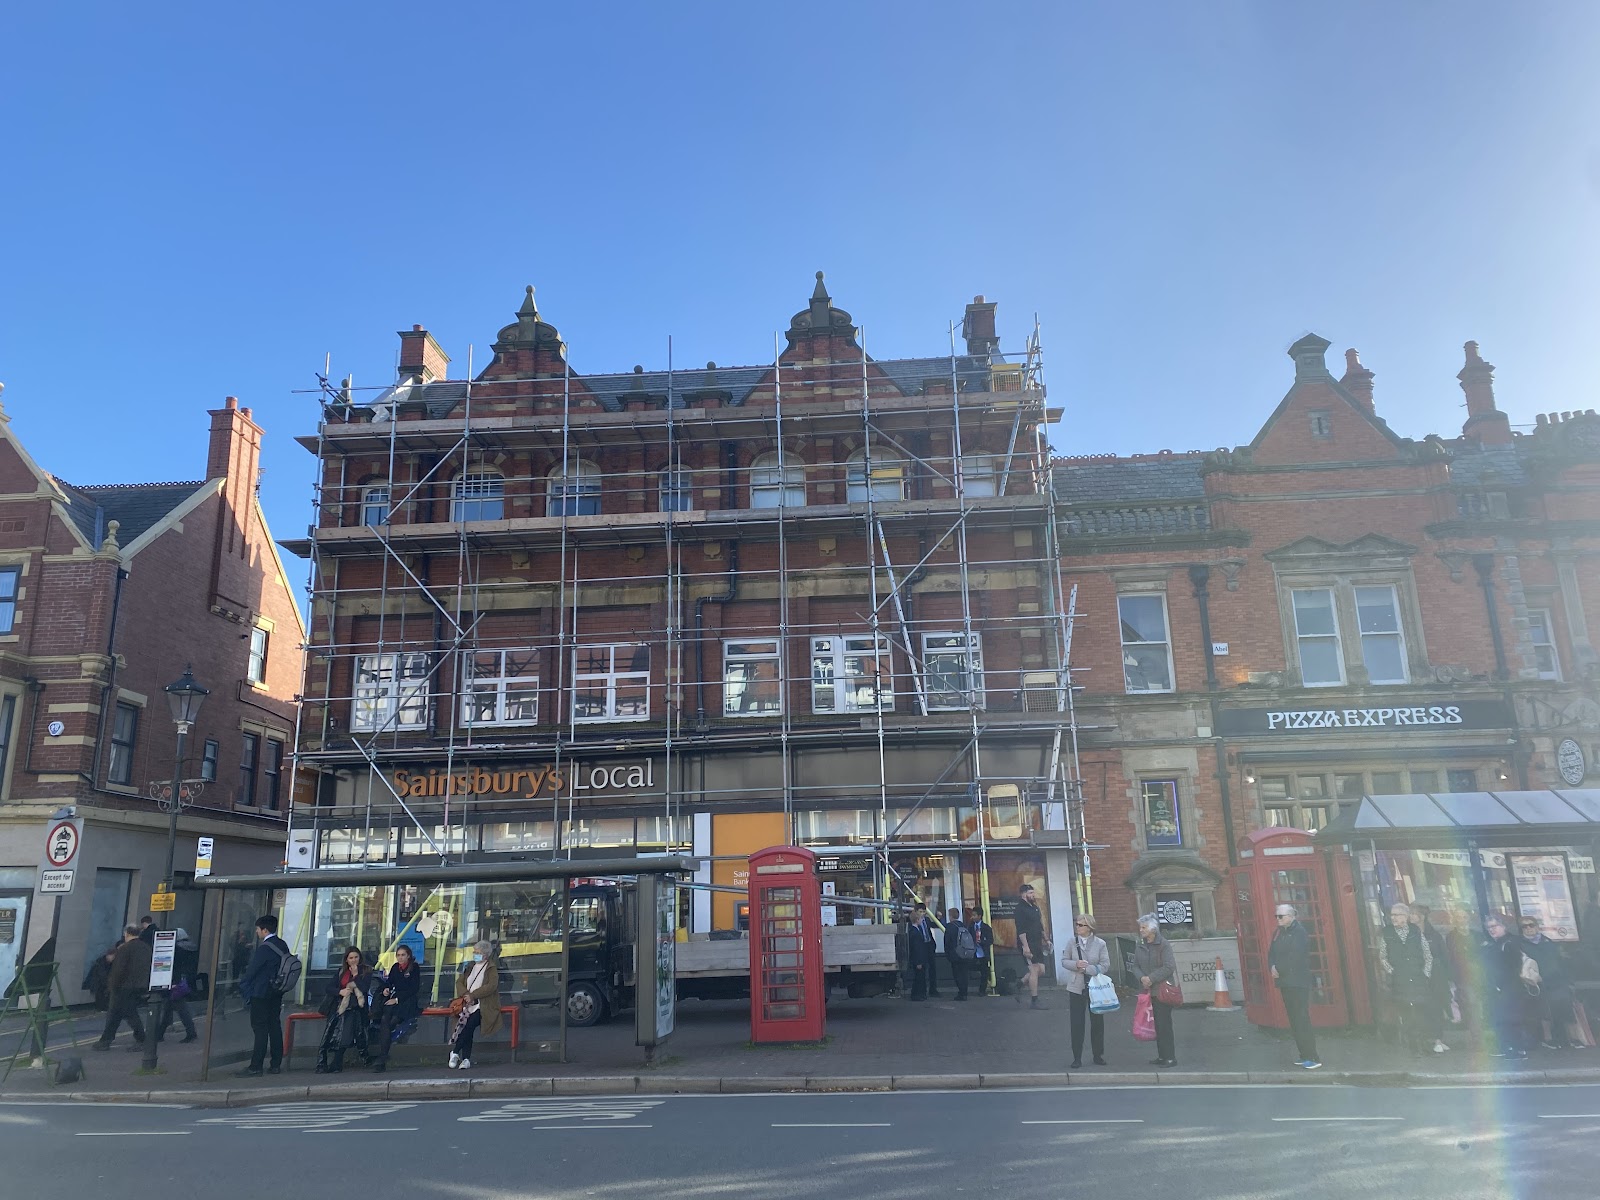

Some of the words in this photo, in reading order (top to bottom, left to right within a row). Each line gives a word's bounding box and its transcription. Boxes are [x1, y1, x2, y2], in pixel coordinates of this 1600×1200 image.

[1266, 710, 1342, 730] PIZZA
[1343, 706, 1463, 727] EXPRESS
[393, 763, 565, 799] Sainsbury's
[573, 757, 654, 790] Local
[733, 870, 750, 878] Sain
[1521, 866, 1541, 875] next
[43, 874, 62, 882] Except
[62, 873, 71, 881] for
[733, 878, 749, 886] Bank
[1190, 961, 1224, 972] PIZZ
[457, 1101, 667, 1122] BUS
